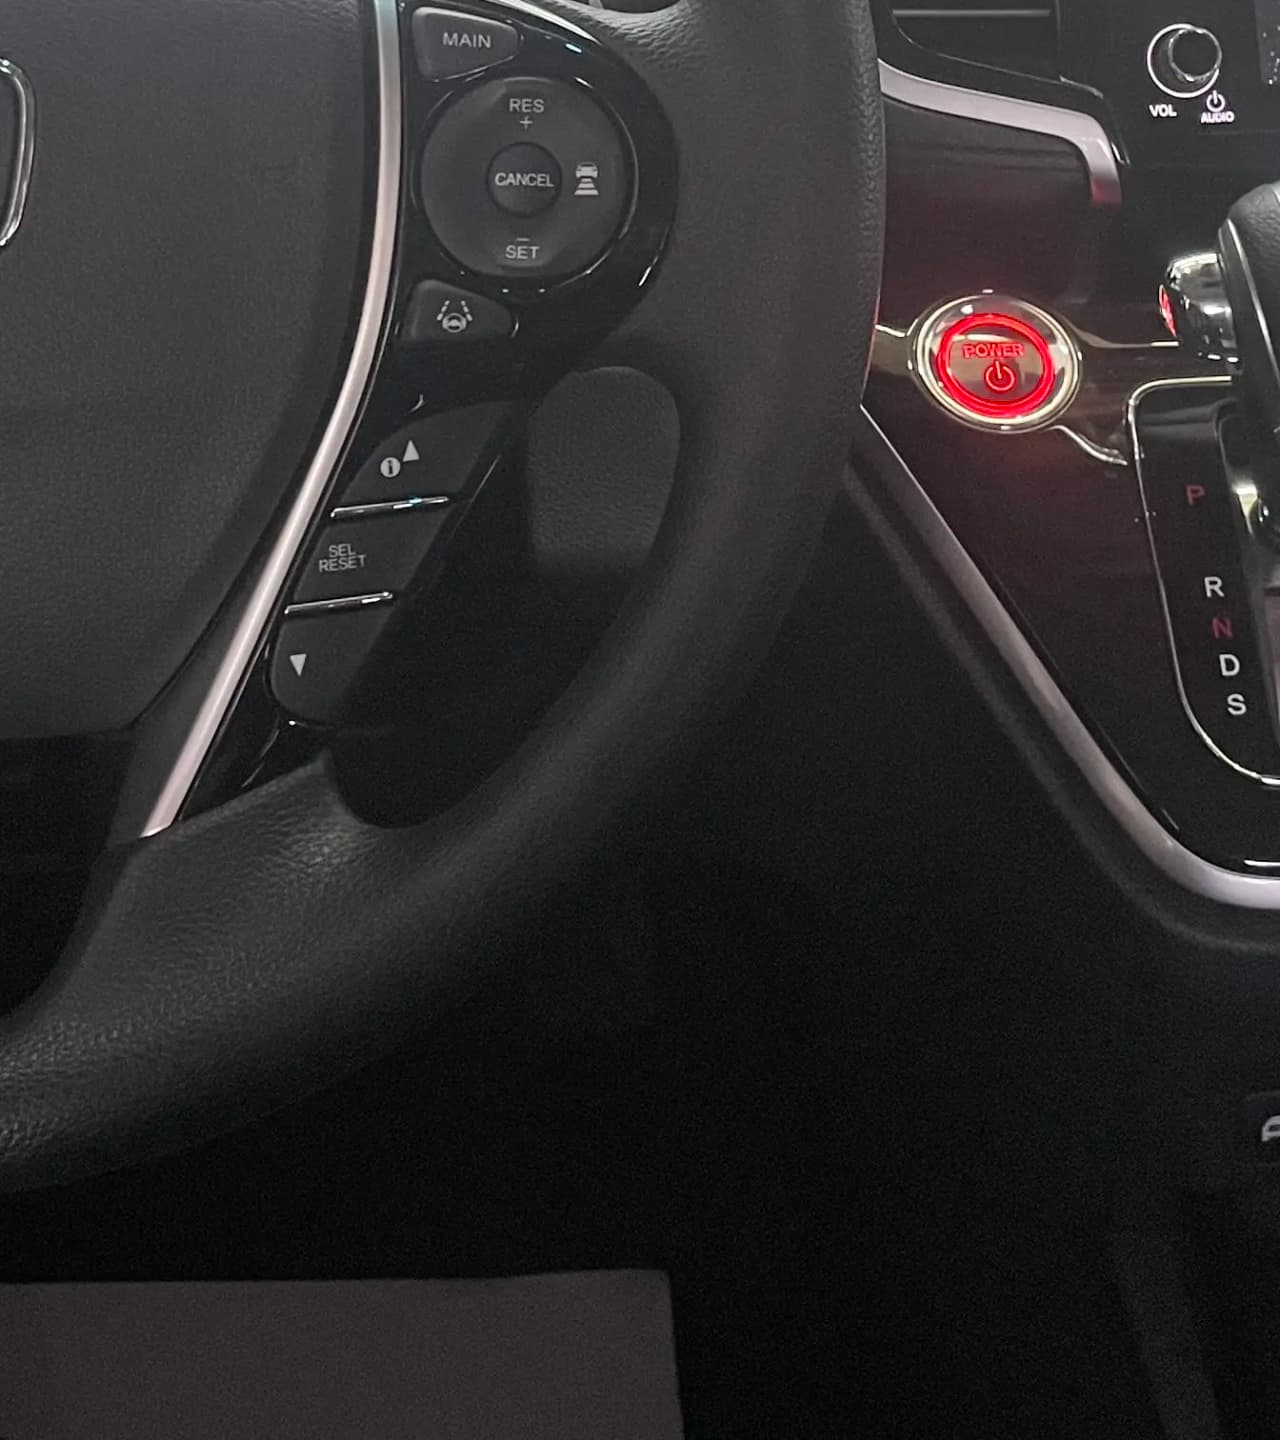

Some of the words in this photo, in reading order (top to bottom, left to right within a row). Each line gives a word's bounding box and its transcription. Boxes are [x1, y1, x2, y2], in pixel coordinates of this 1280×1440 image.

[442, 31, 492, 49] MAIN
[508, 98, 545, 114] RES
[1149, 104, 1177, 118] VOL
[1200, 110, 1235, 123] AUDIO
[494, 172, 554, 188] CANCEL
[505, 245, 540, 261] SET
[962, 343, 1025, 359] POWER
[1185, 485, 1206, 505] P
[328, 544, 355, 557] SEL
[319, 555, 366, 573] RESET
[1204, 576, 1225, 598] R
[1212, 617, 1233, 639] N
[1219, 654, 1240, 677] D
[1227, 693, 1247, 716] S
